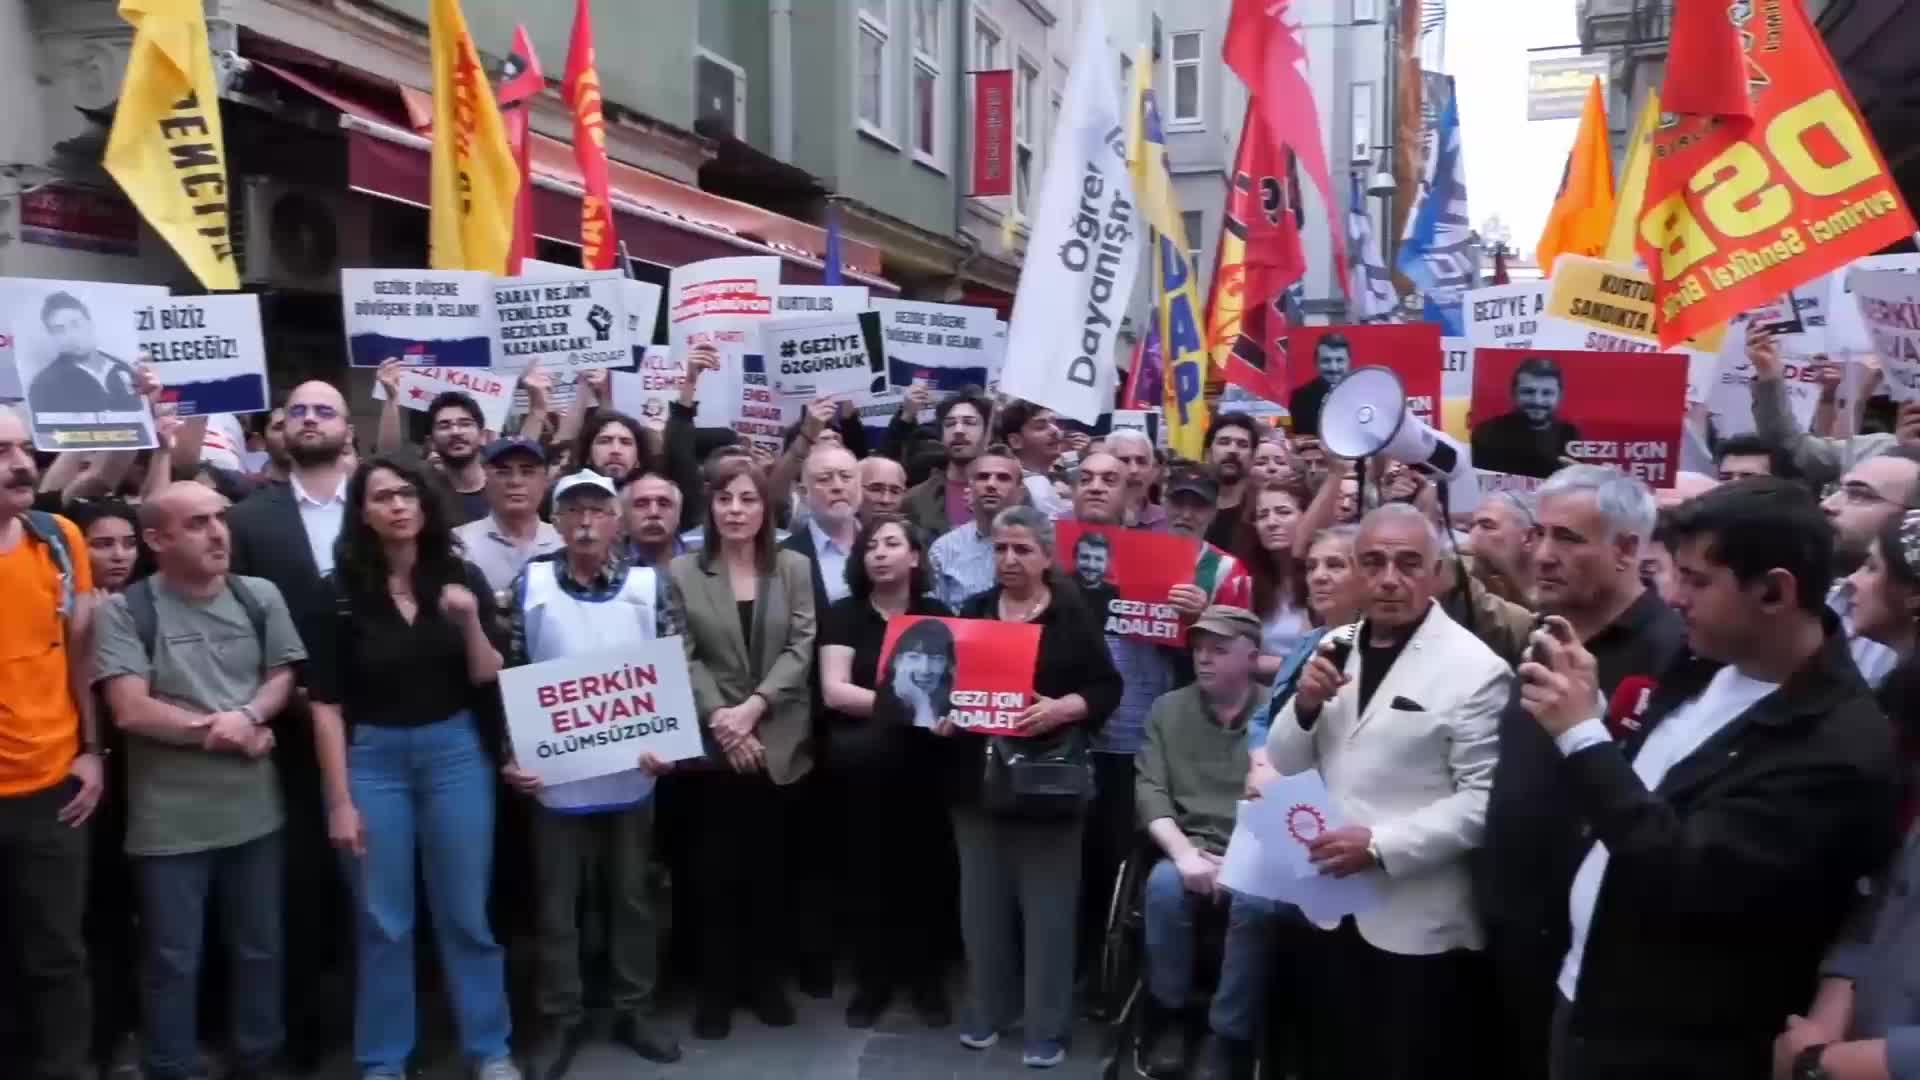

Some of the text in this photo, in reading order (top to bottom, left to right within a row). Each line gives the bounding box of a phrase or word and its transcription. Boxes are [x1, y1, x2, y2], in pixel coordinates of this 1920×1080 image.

[495, 281, 592, 305] SARAY REJİMİ
[161, 304, 207, 330] BİZİZ
[498, 303, 572, 323] YENİLECEK
[501, 320, 569, 340] GEZİCİLER
[503, 336, 593, 356] KAZANACAK!
[780, 350, 866, 376] ÖZGÜRLÜK
[1565, 440, 1668, 459] GEZİ İÇİN
[1108, 599, 1146, 617] GEZİ
[1105, 615, 1179, 638] ADALET!
[537, 663, 658, 708] BERKİN
[951, 690, 1024, 709] GEZİ İÇİN
[552, 692, 657, 734] ELVAN
[536, 715, 680, 759] ÖLÜMSÜZDÜR
